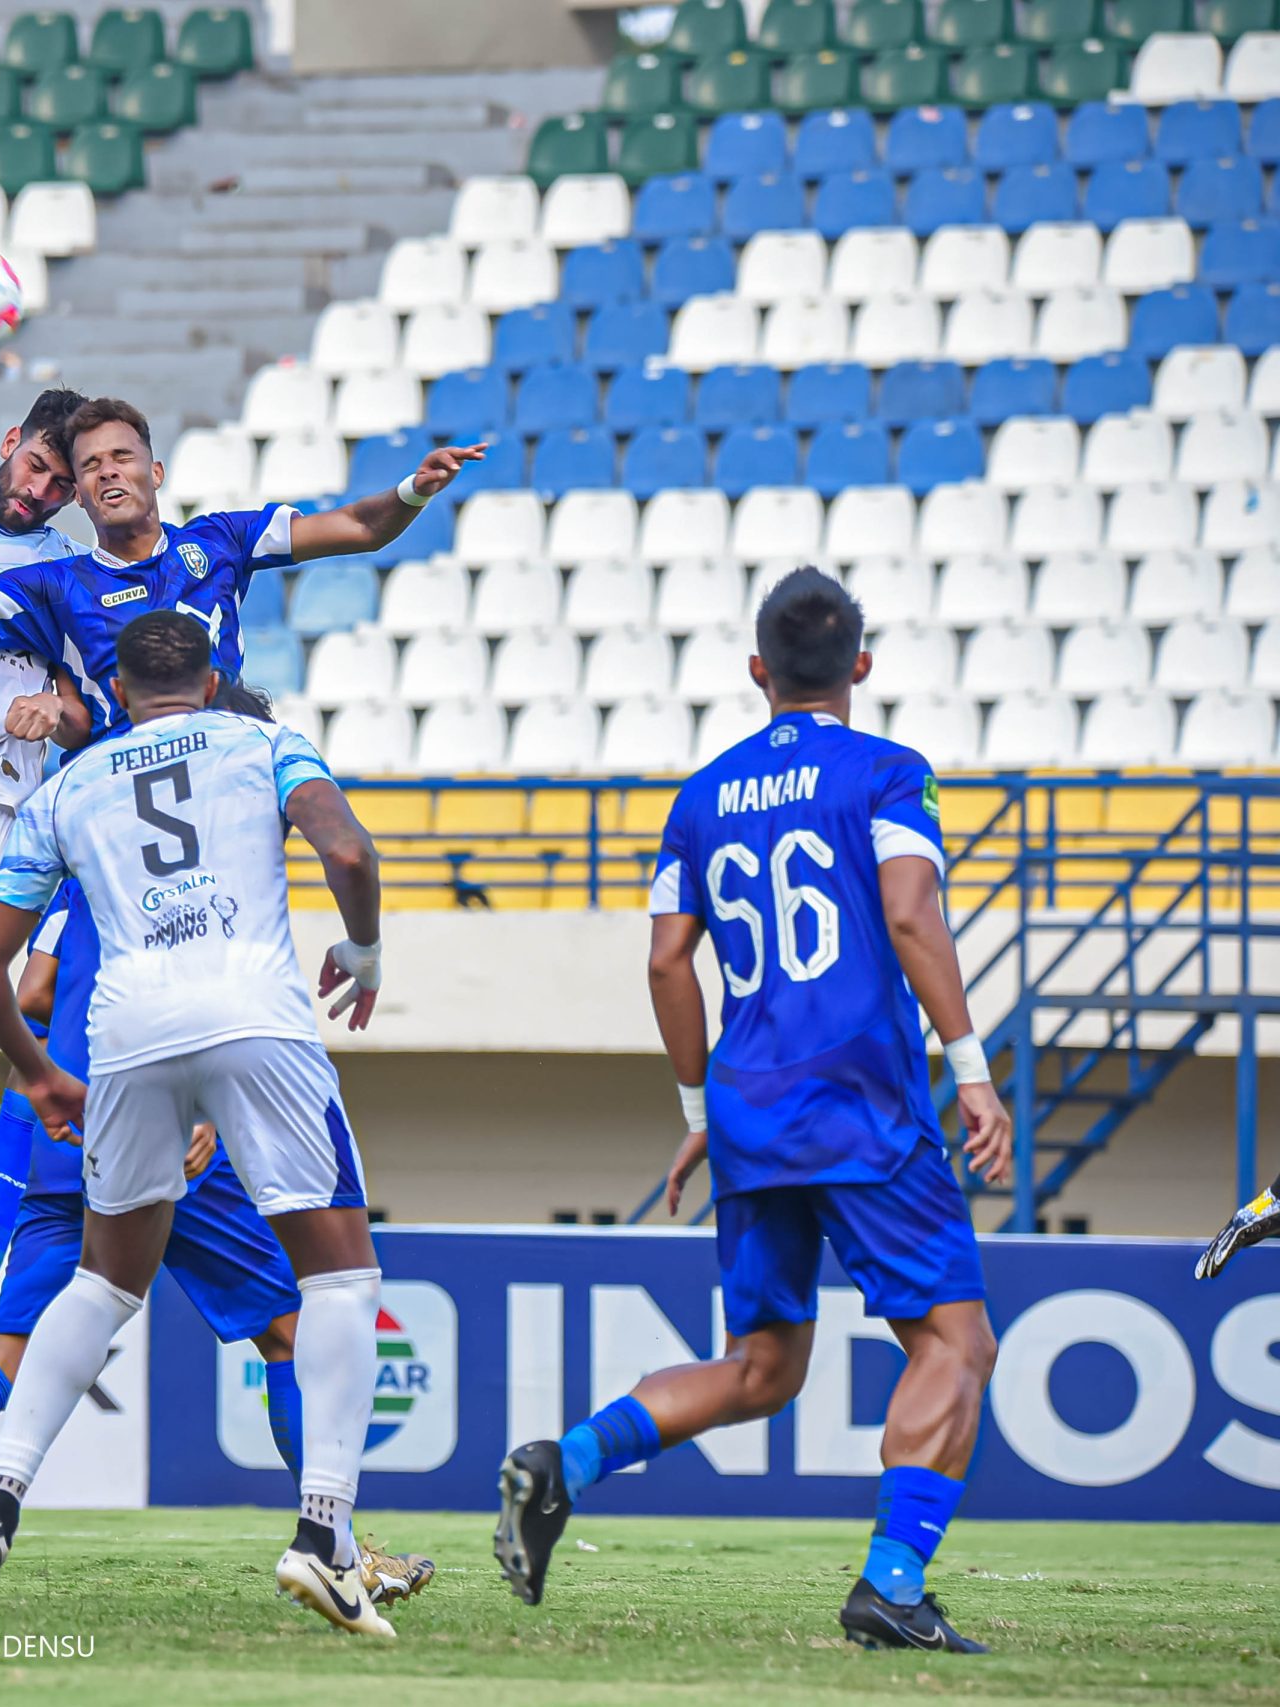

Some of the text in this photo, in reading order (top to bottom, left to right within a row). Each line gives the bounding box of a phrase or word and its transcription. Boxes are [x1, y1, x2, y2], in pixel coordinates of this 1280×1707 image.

[110, 731, 208, 775] PEREIRA
[132, 759, 200, 878] 5
[706, 829, 840, 998] 56
